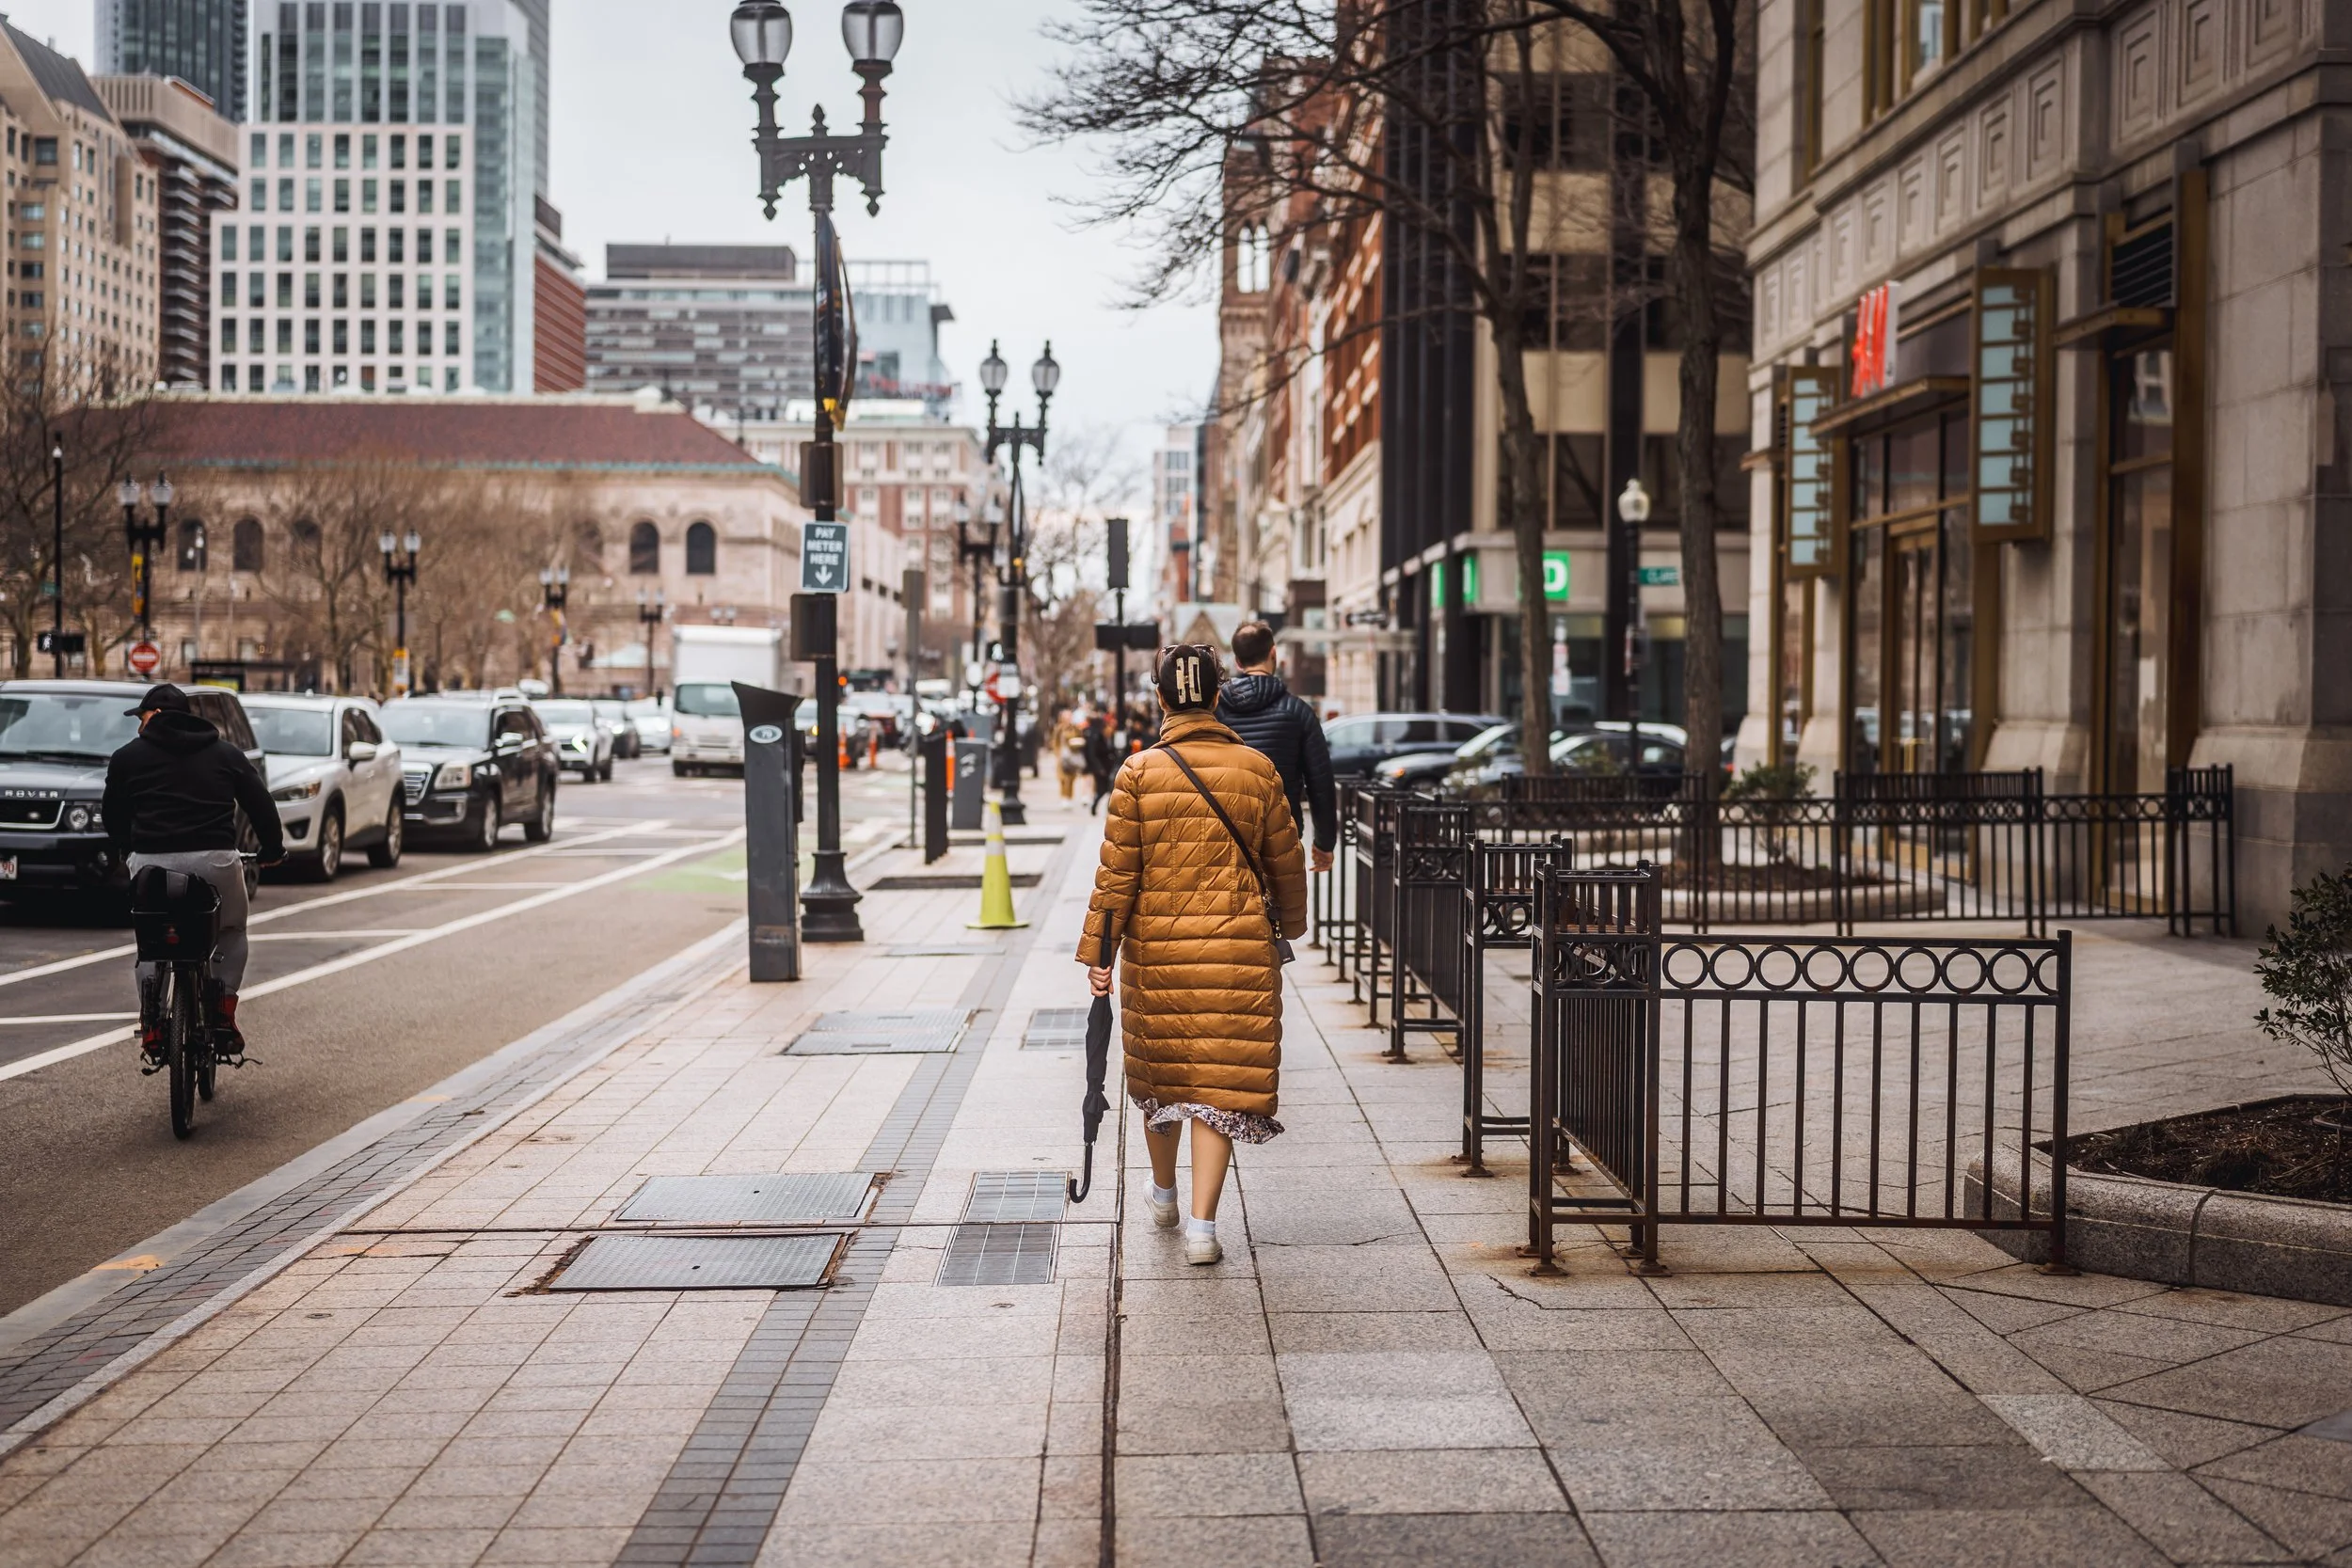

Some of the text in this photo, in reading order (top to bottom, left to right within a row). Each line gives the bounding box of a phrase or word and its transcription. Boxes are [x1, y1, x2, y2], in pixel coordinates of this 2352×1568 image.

[815, 527, 836, 539] PAY
[806, 539, 843, 553] METER
[810, 552, 839, 565] HERE
[5, 789, 58, 798] ROVER
